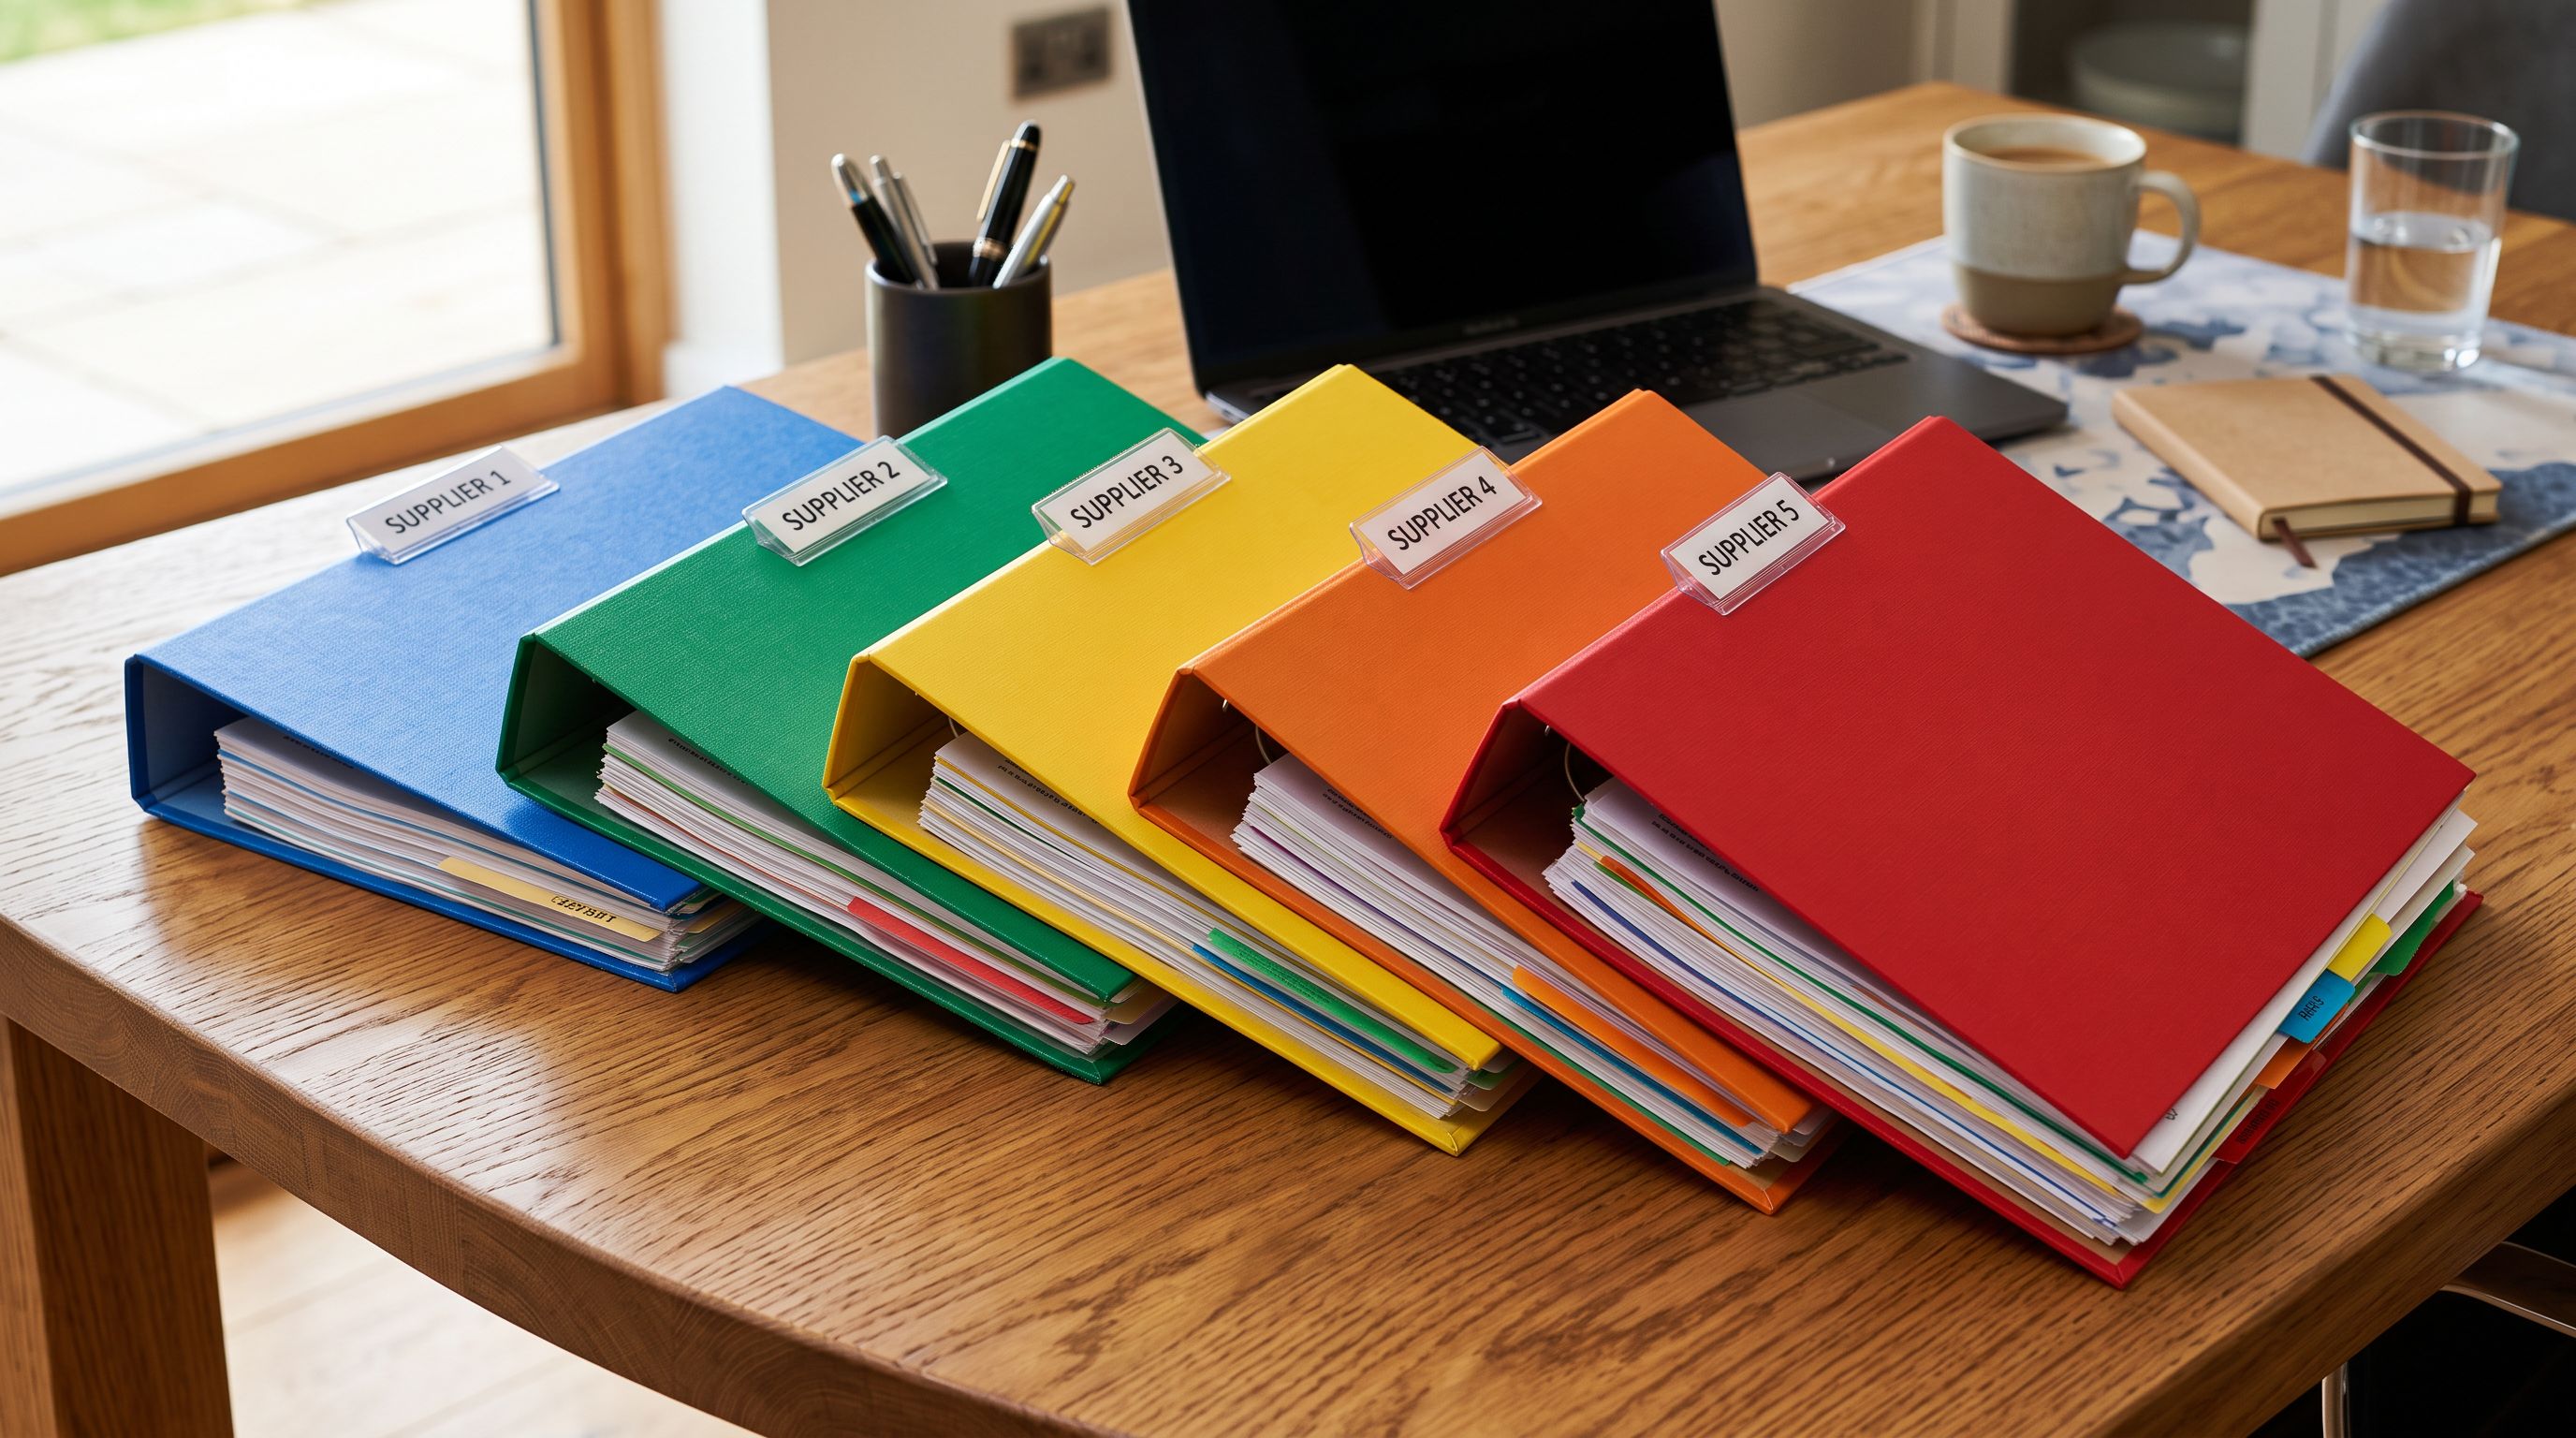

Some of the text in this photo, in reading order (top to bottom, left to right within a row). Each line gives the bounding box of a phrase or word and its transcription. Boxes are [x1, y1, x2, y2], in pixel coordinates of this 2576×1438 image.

[385, 471, 511, 536] SUPPLIER 1
[781, 461, 900, 532] SUPPLIER 2
[1070, 455, 1183, 530] SUPPLIER 3
[1387, 476, 1499, 550] SUPPLIER 4
[1698, 499, 1799, 576] SUPPLIER 5
